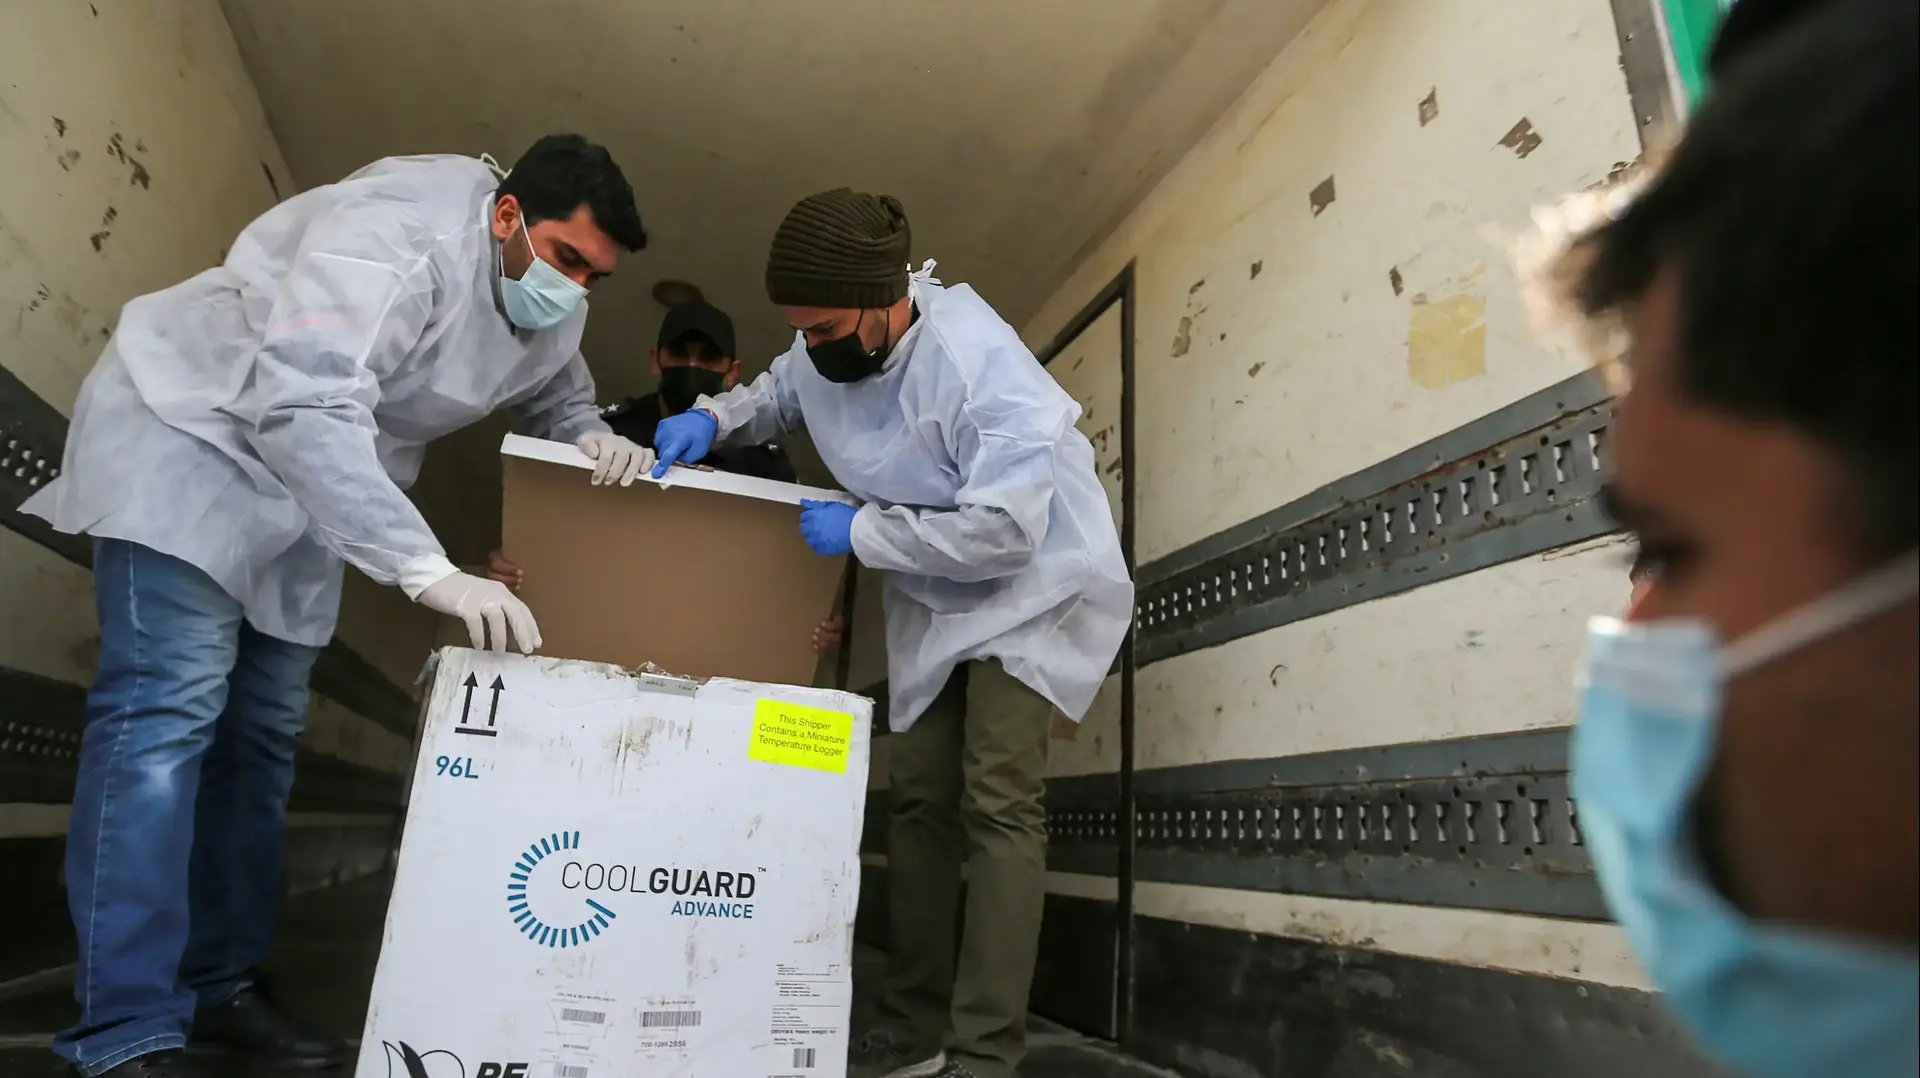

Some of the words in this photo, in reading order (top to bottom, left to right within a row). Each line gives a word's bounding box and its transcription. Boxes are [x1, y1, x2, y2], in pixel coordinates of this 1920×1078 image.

[779, 714, 797, 725] This
[798, 718, 832, 731] Shipper
[759, 723, 797, 737] Contains
[799, 731, 805, 739] a
[807, 731, 846, 745] Miniature
[758, 735, 812, 751] Temperature
[813, 744, 844, 757] Logger
[436, 755, 479, 779] 96L
[562, 862, 756, 899] COOLGUARD
[671, 901, 754, 919] ADVANCE
